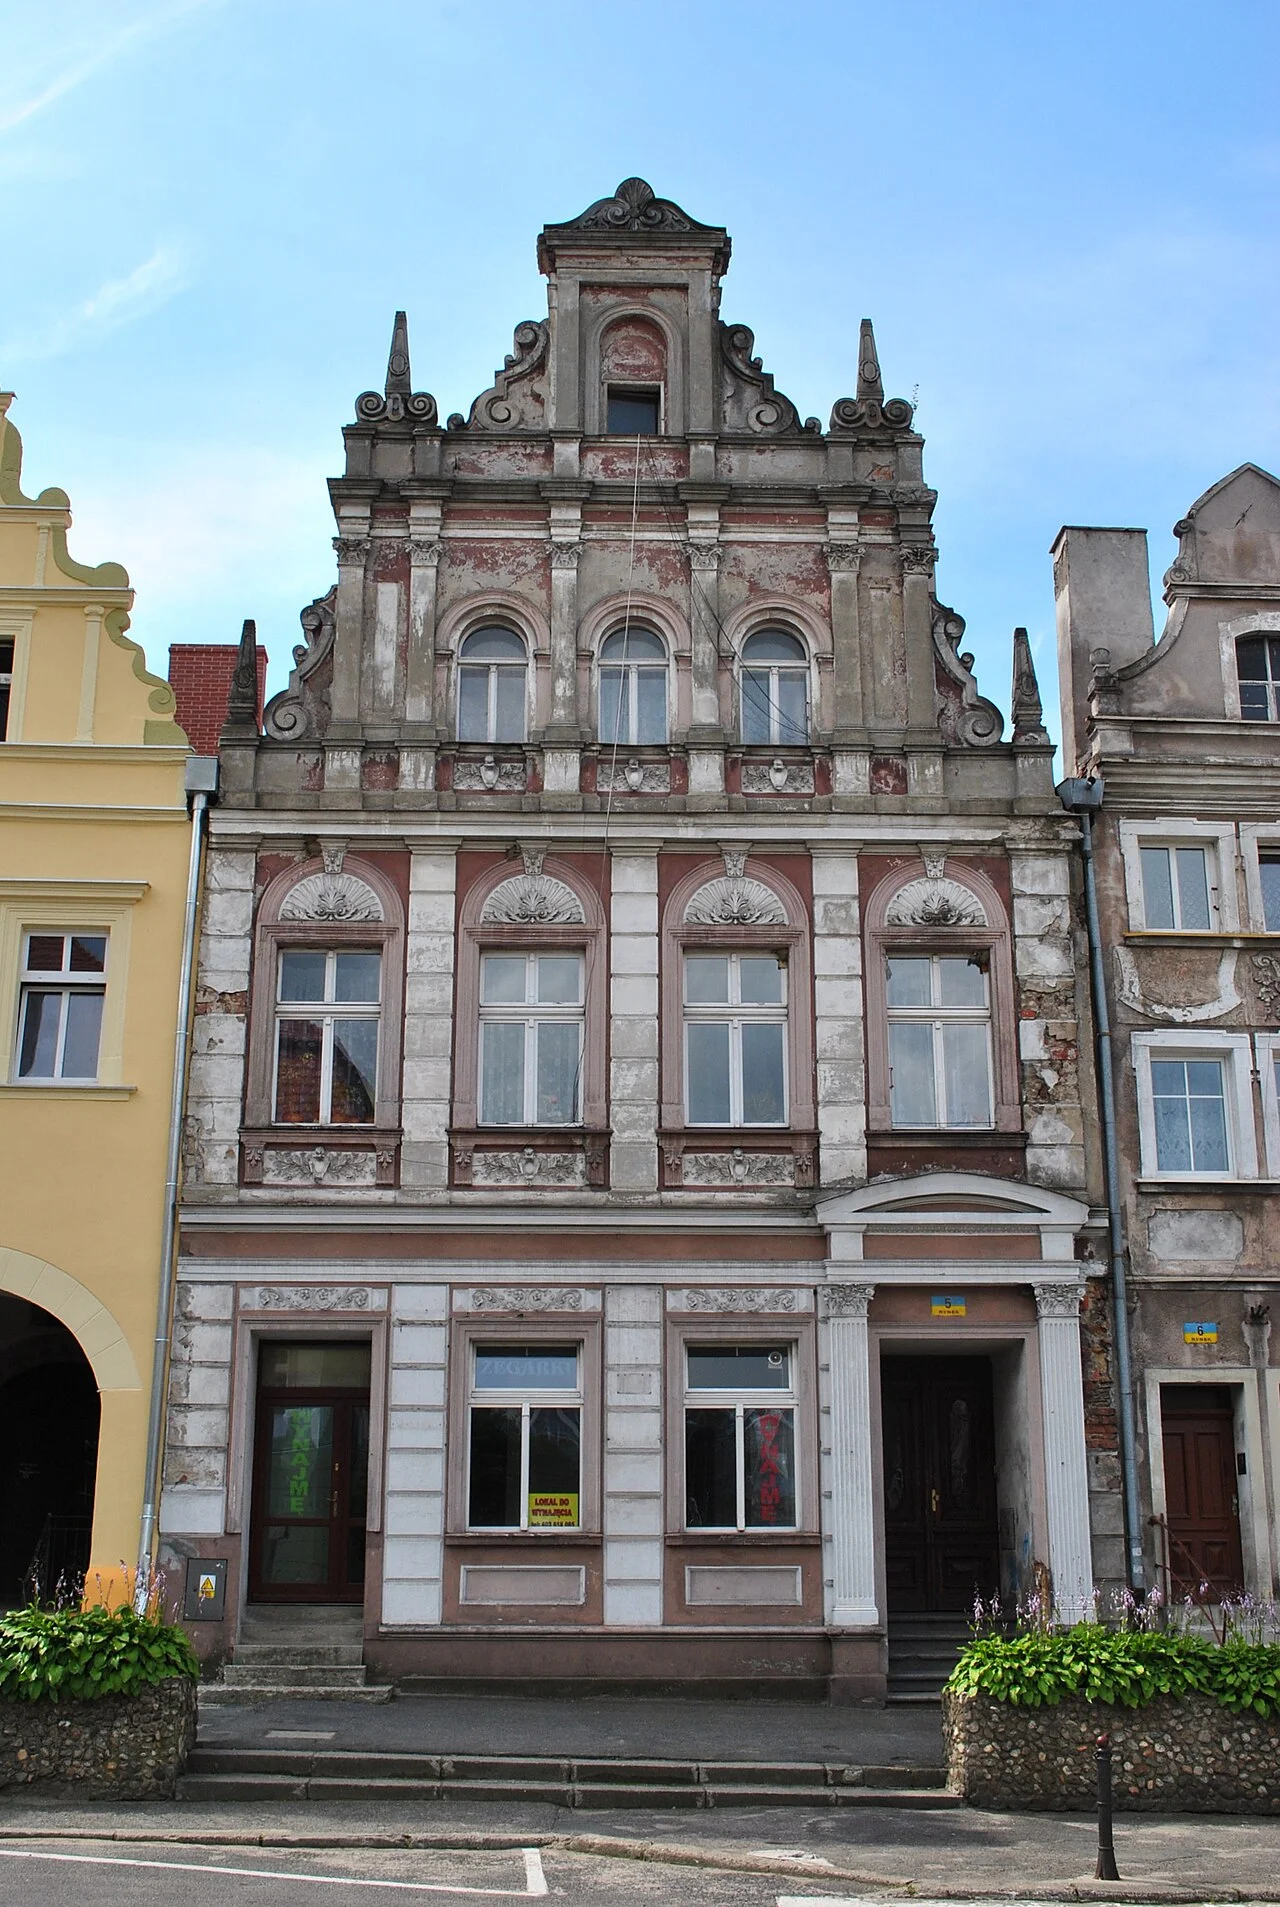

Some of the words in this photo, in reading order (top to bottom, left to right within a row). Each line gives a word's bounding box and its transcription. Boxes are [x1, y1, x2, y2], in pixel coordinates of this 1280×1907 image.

[944, 1297, 952, 1309] 5
[1197, 1325, 1204, 1336] 6
[535, 1498, 558, 1506] LOKAL
[559, 1498, 570, 1506] DO
[531, 1508, 573, 1518] WYNAJĘCIA
